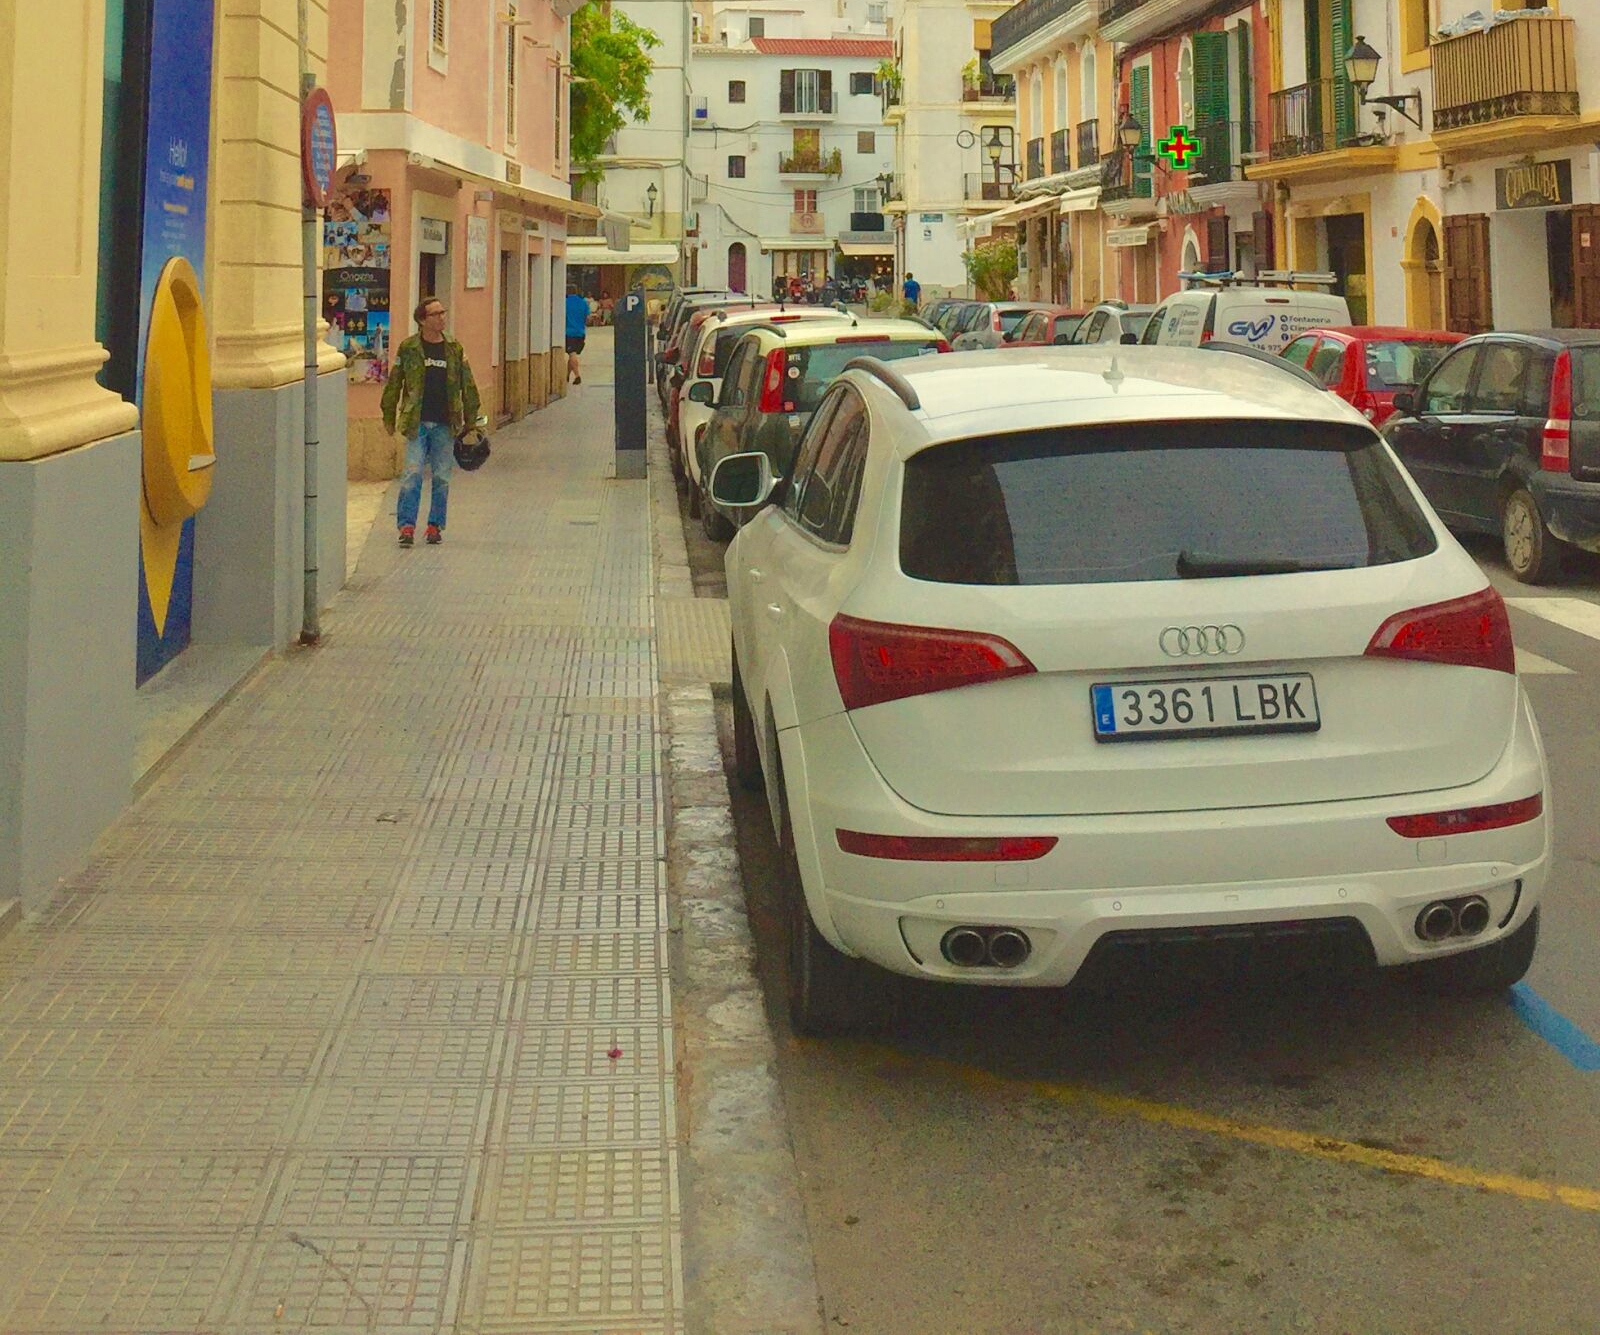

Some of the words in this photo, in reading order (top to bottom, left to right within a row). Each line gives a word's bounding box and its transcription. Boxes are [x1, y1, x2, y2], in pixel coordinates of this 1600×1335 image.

[627, 296, 640, 311] P
[1121, 686, 1215, 726] 3361
[1232, 682, 1307, 722] LBK
[1101, 714, 1110, 725] E
